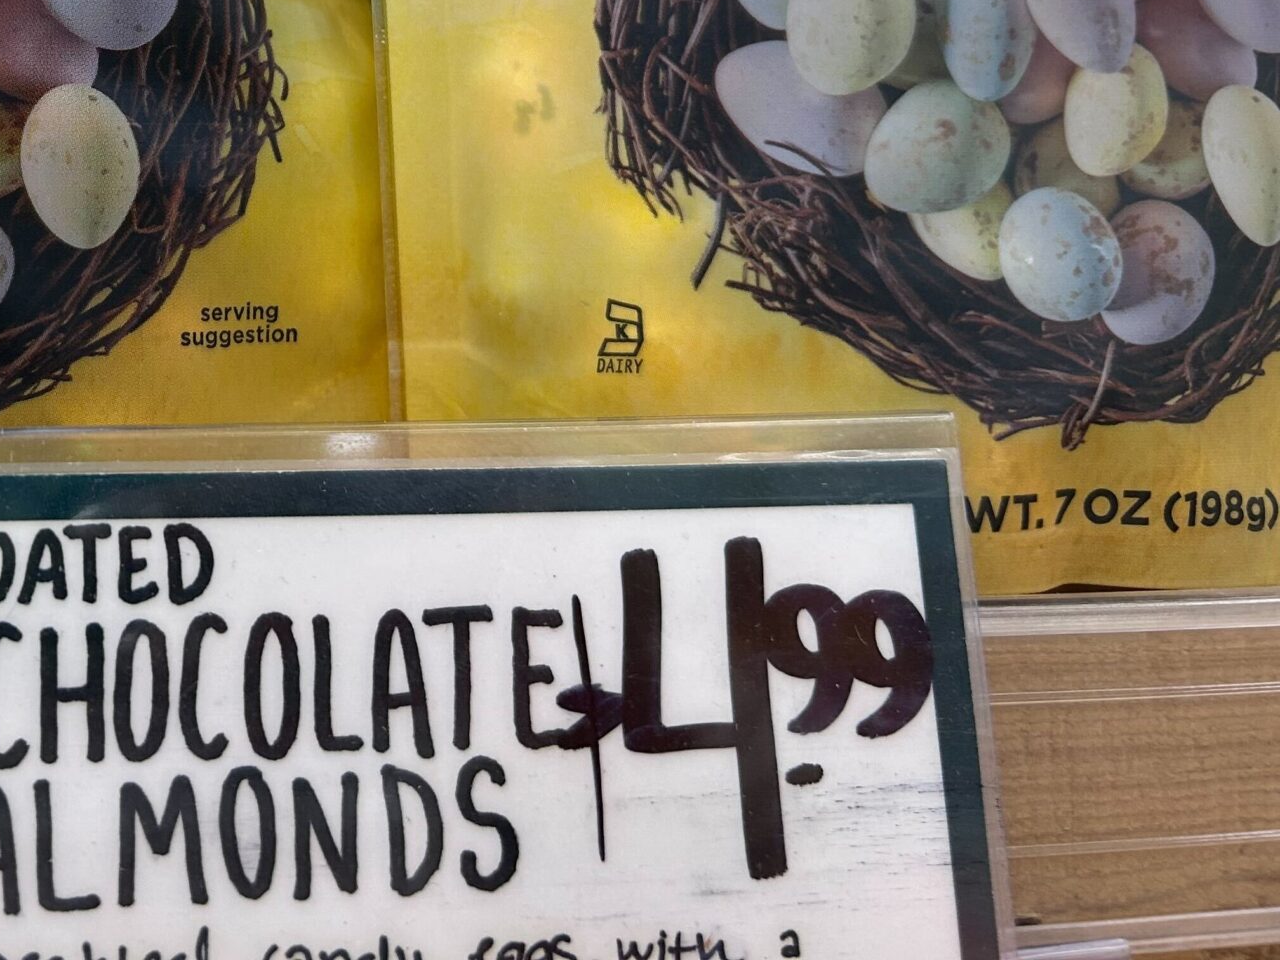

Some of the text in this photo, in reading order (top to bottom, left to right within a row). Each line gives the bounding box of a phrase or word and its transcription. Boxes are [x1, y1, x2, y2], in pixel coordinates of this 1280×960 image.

[200, 301, 279, 323] serving
[180, 324, 299, 349] suggestion
[596, 358, 644, 374] DAIRY
[963, 493, 1044, 533] WT.
[1163, 487, 1279, 533] (198g)
[778, 929, 802, 958] a
